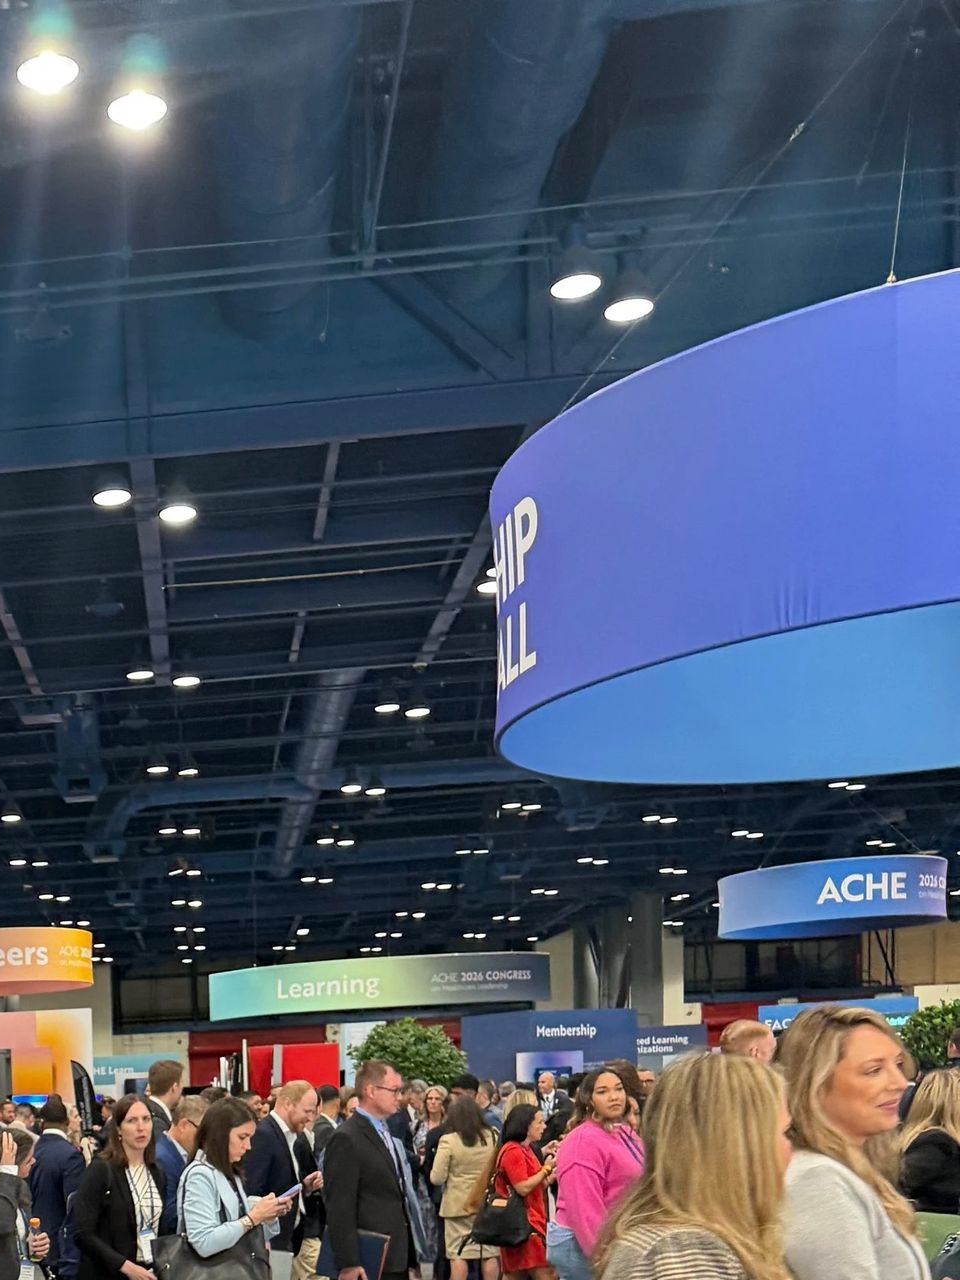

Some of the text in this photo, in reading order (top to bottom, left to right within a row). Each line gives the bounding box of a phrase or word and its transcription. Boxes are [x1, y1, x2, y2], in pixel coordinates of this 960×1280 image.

[816, 872, 908, 905] ACHE
[431, 969, 532, 983] ACHE 2026 CONGRESS
[277, 975, 381, 999] Learning
[536, 1023, 597, 1039] Membership
[652, 1034, 689, 1046] Learning
